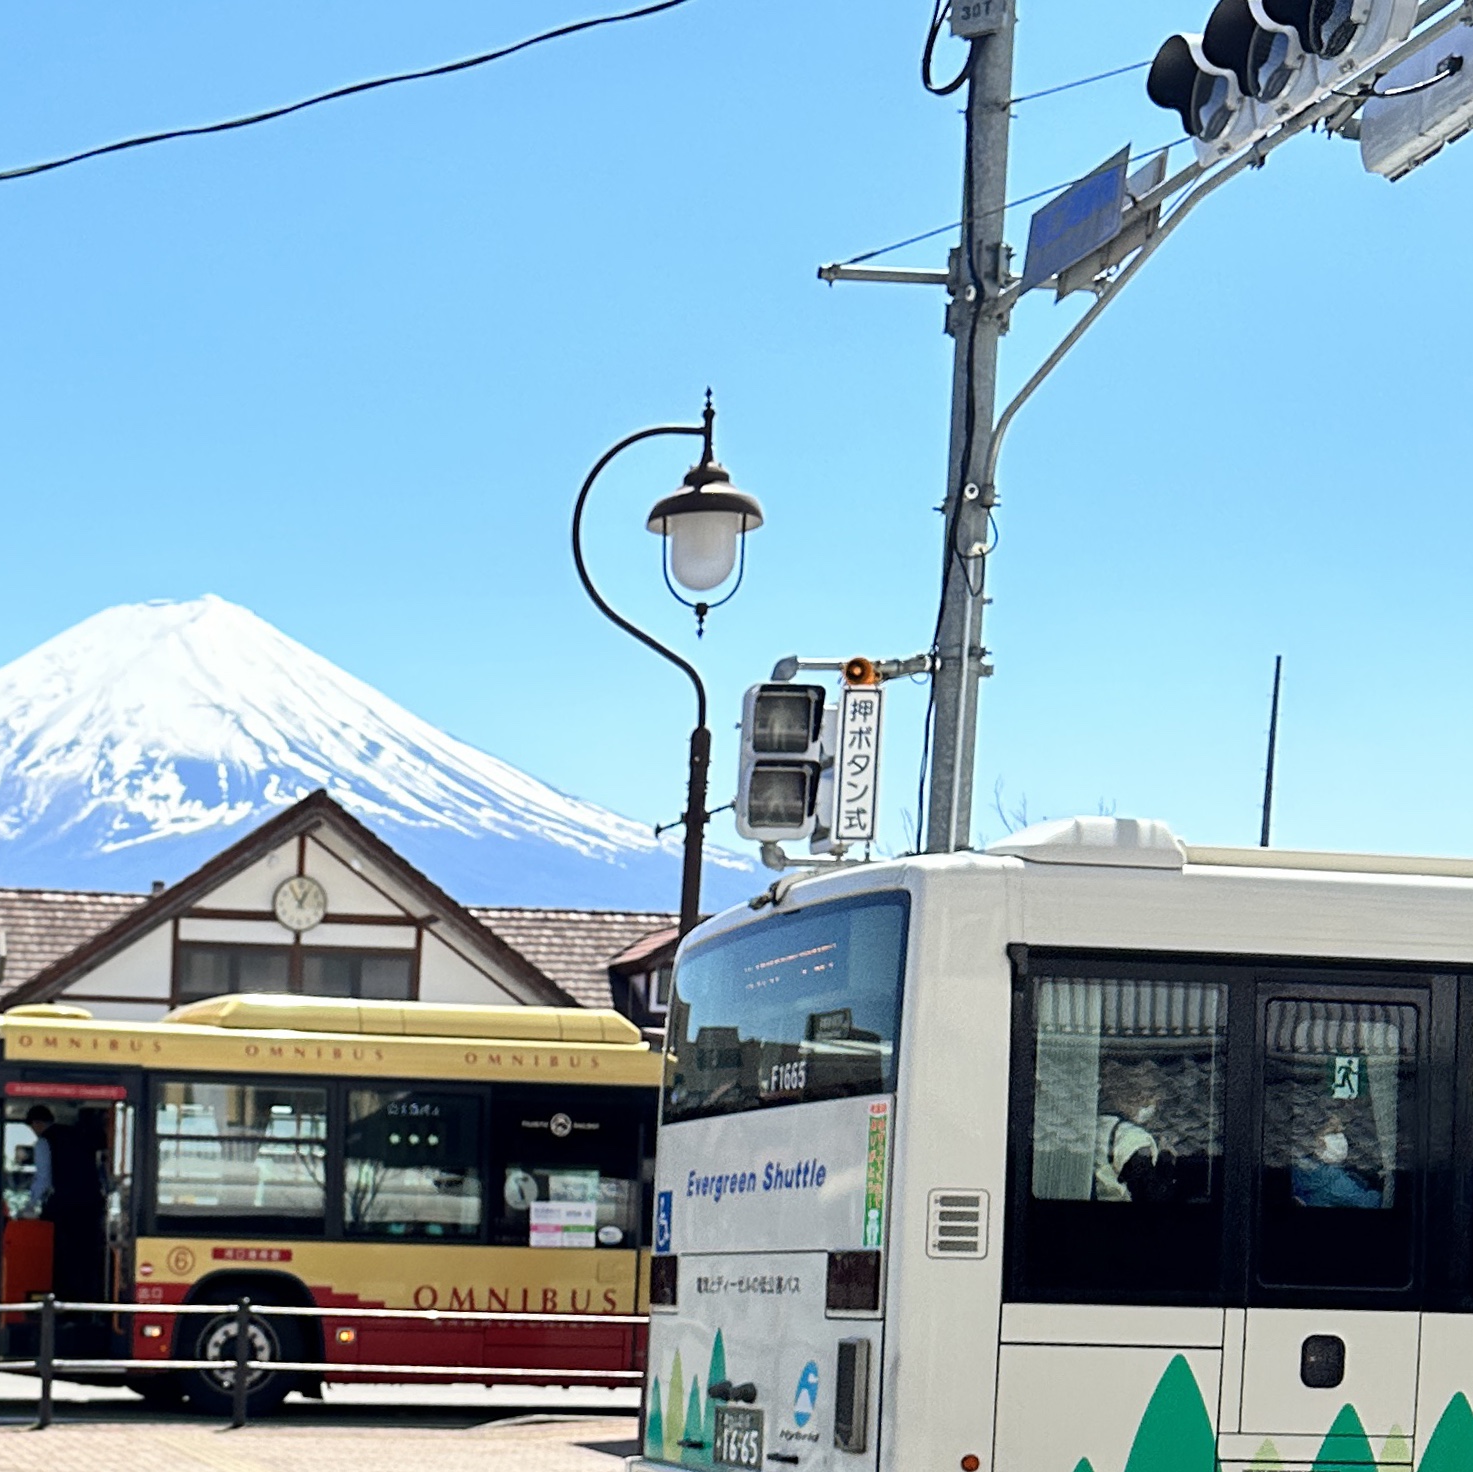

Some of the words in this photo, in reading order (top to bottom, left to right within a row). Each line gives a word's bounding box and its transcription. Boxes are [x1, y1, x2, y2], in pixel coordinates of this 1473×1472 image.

[845, 699, 874, 831] 押ボタン式
[18, 1034, 162, 1053] OMNIBUS
[244, 1044, 384, 1061] OMNIBUS
[464, 1051, 600, 1069] OMNIBUS
[686, 1170, 757, 1203] Evergreen
[762, 1158, 827, 1192] Shuttle
[413, 1284, 617, 1313] OMNIBUS
[779, 1428, 820, 1443] Hybrid
